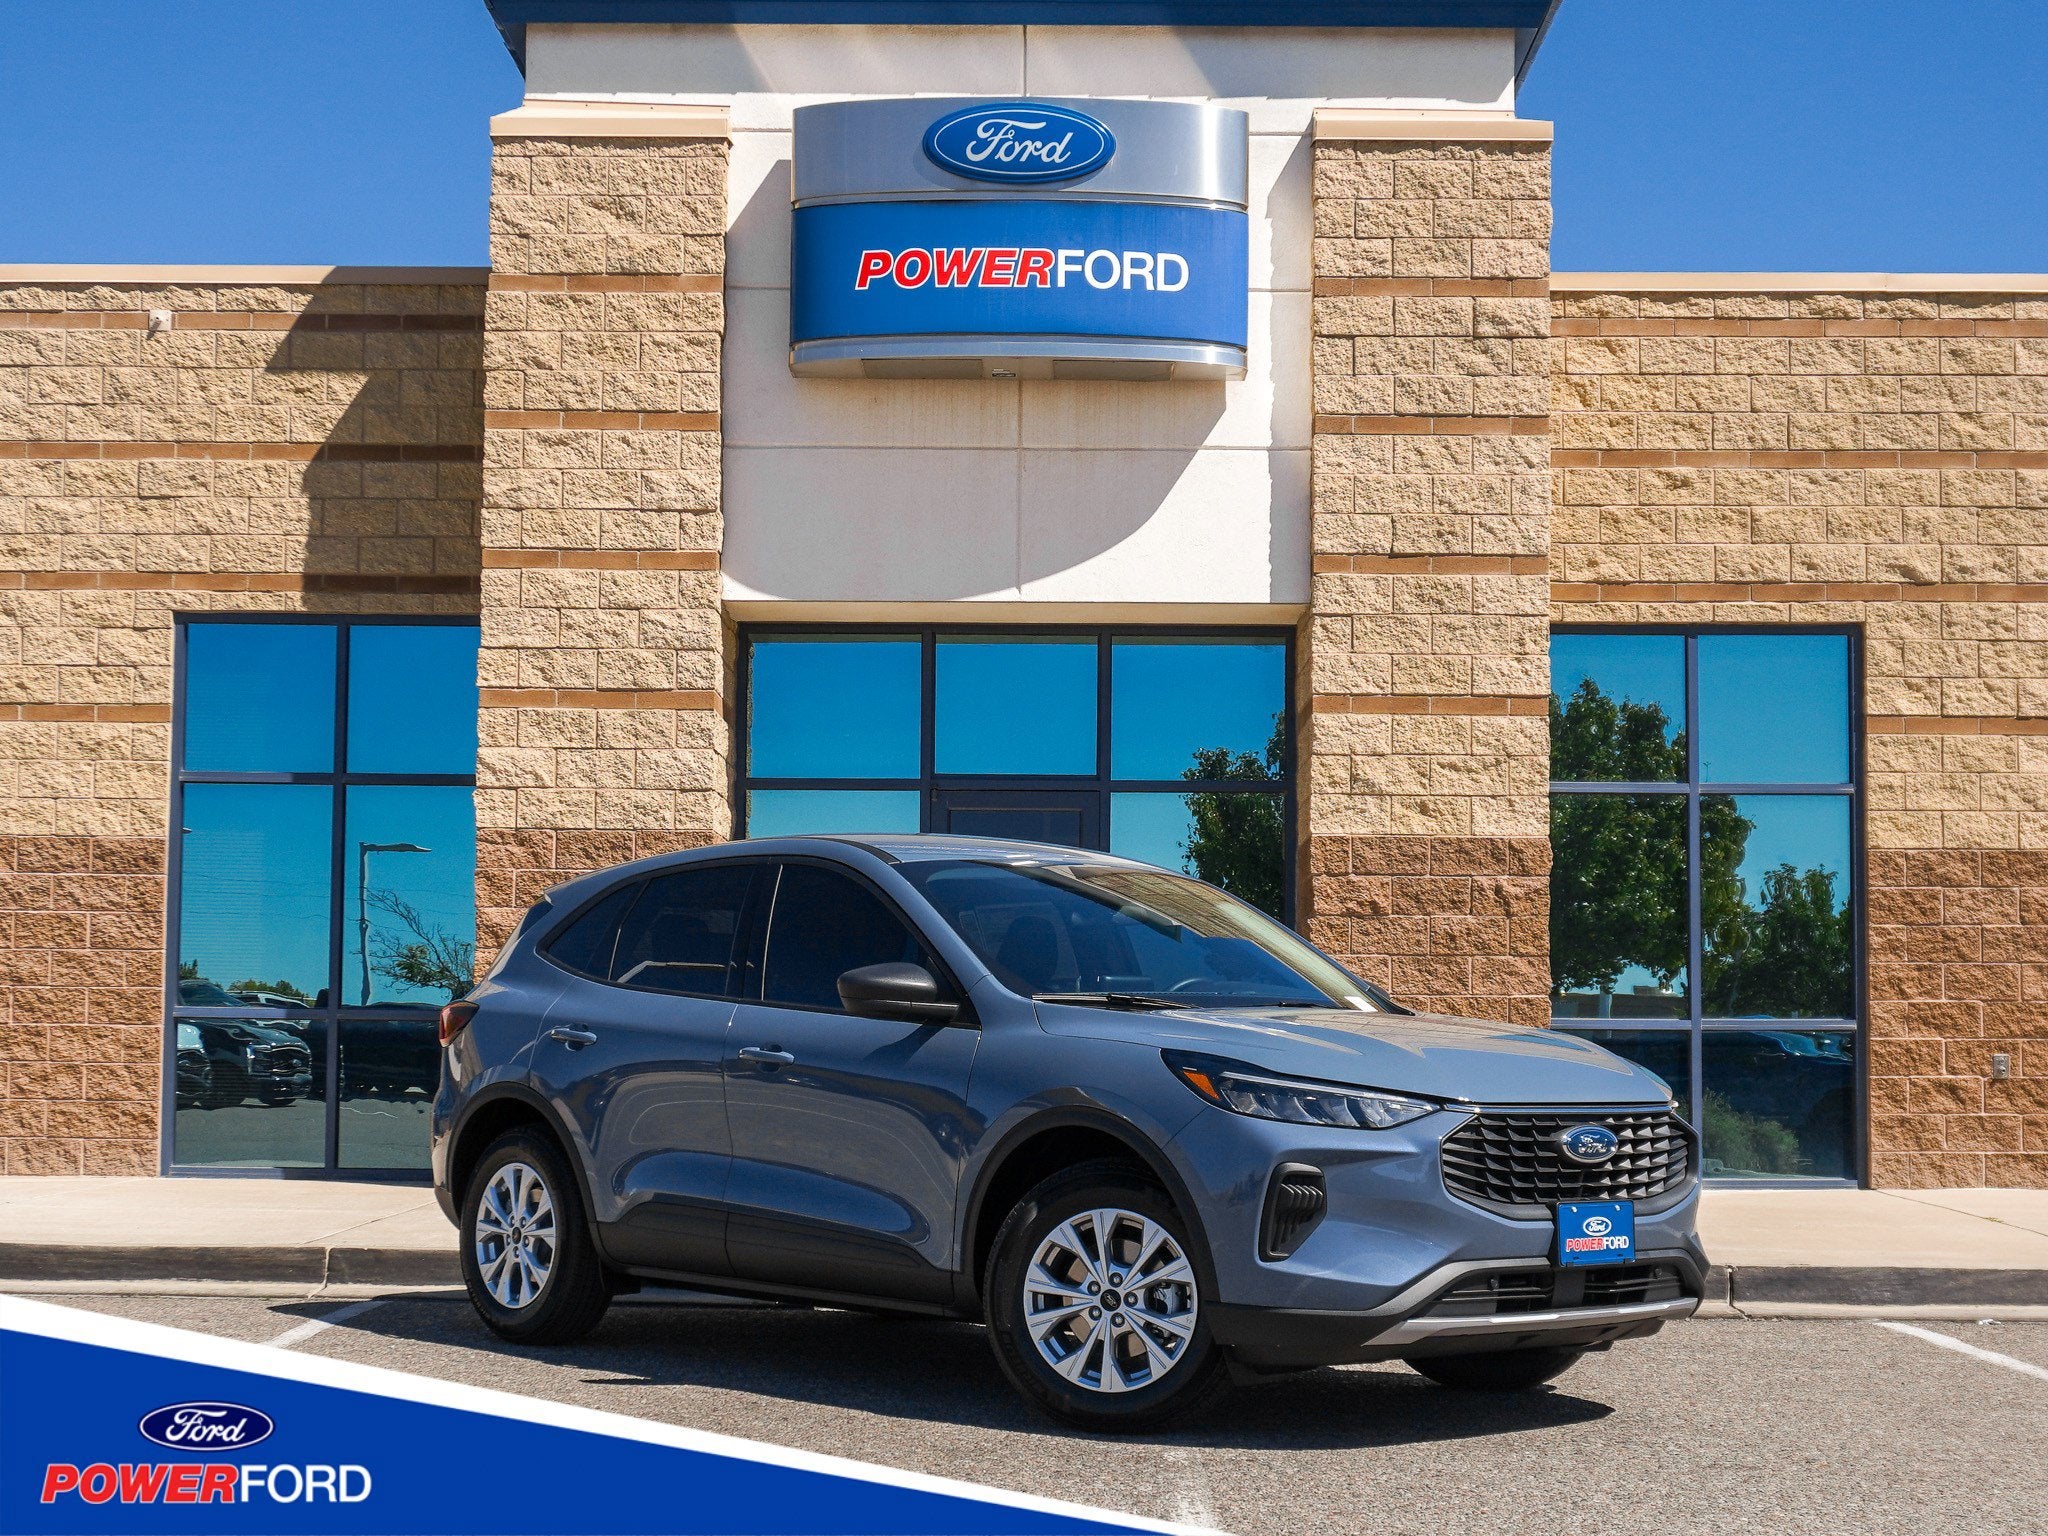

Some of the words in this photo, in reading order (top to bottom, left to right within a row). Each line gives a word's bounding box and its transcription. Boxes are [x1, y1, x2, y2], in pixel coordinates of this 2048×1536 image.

[965, 117, 1073, 165] Ford
[855, 247, 1189, 292] POWERFORD
[1588, 1220, 1606, 1232] Ford
[1565, 1235, 1630, 1253] POWERFORD
